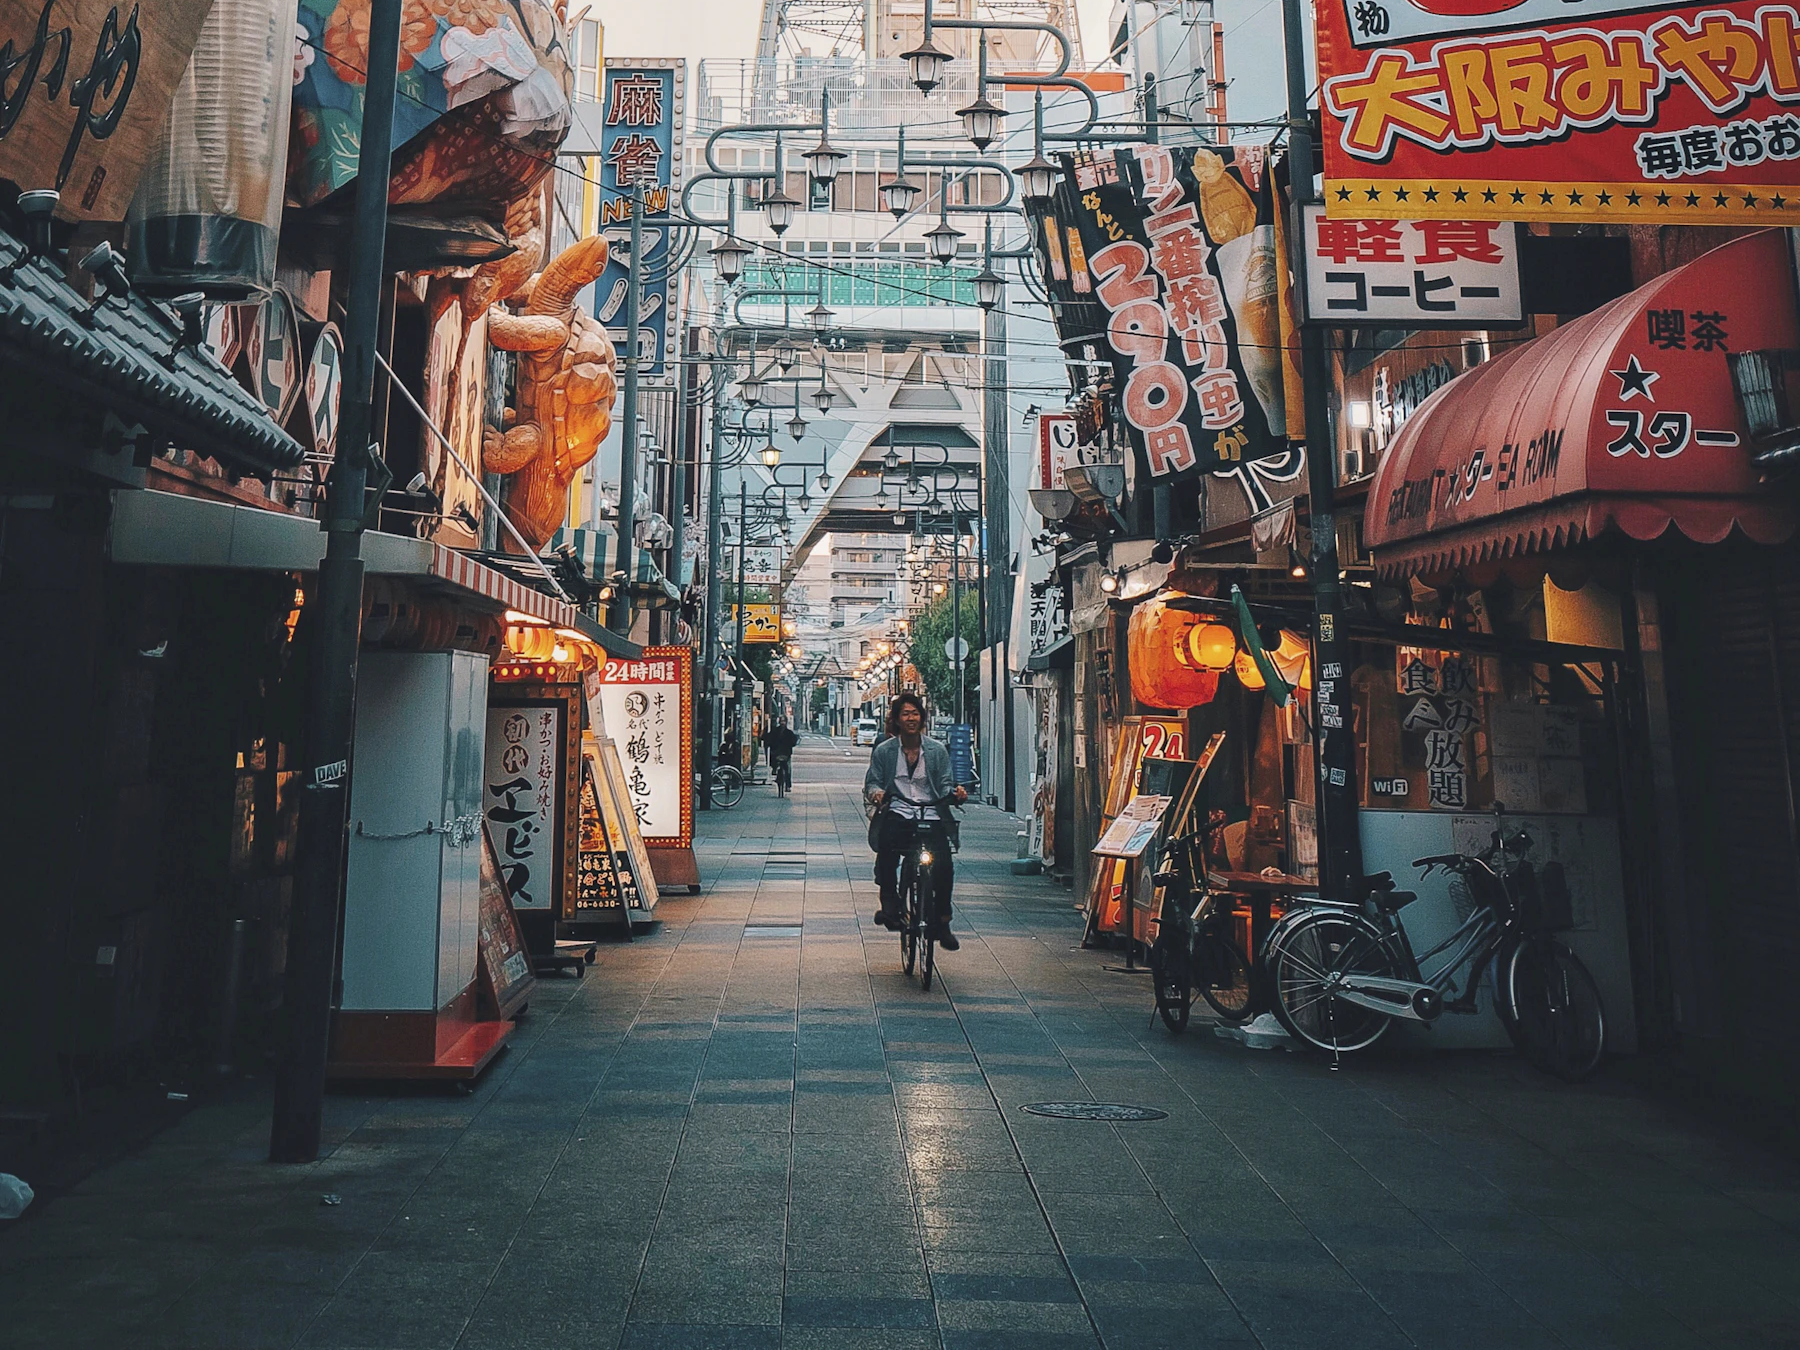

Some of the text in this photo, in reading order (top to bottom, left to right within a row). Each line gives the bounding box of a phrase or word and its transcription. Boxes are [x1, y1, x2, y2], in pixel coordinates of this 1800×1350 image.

[605, 73, 664, 187] 麻雀
[1315, 218, 1505, 264] 軽食
[1325, 270, 1500, 312] コーヒー
[1089, 240, 1197, 477] 290円
[1647, 309, 1729, 352] 喫茶
[1605, 409, 1741, 459] スター
[1401, 658, 1442, 730] 食べ
[1440, 657, 1480, 733] 飲み
[317, 761, 346, 782] DAVE
[503, 715, 530, 774] 初代
[1425, 732, 1467, 808] 放題
[487, 777, 541, 903] エビス
